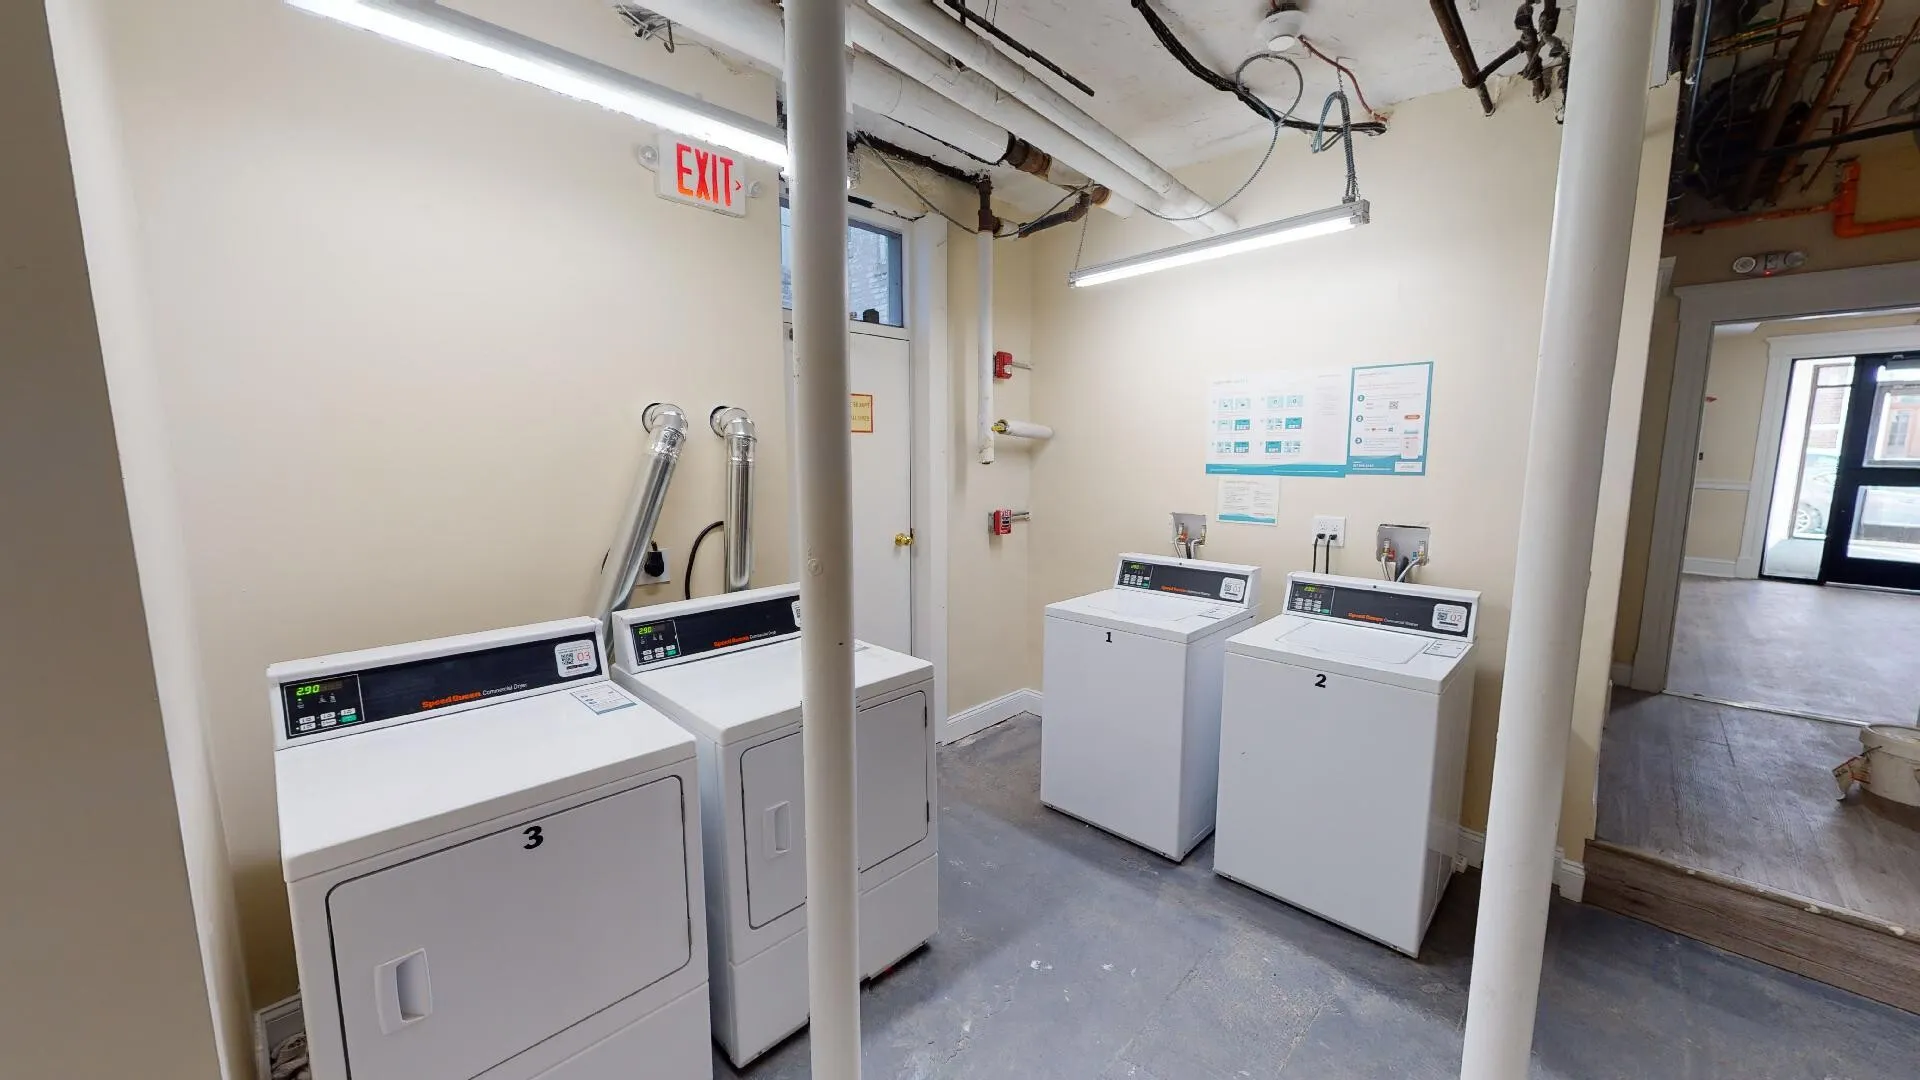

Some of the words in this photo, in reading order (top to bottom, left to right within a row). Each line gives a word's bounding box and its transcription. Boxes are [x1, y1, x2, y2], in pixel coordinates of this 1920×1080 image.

[676, 142, 734, 207] EXIT
[1105, 632, 1113, 643] 1
[1314, 673, 1327, 688] 2
[422, 696, 452, 708] Speed
[452, 691, 481, 702] Queen
[482, 686, 512, 696] Commercial
[513, 683, 528, 691] Dryer
[522, 825, 544, 850] 3
